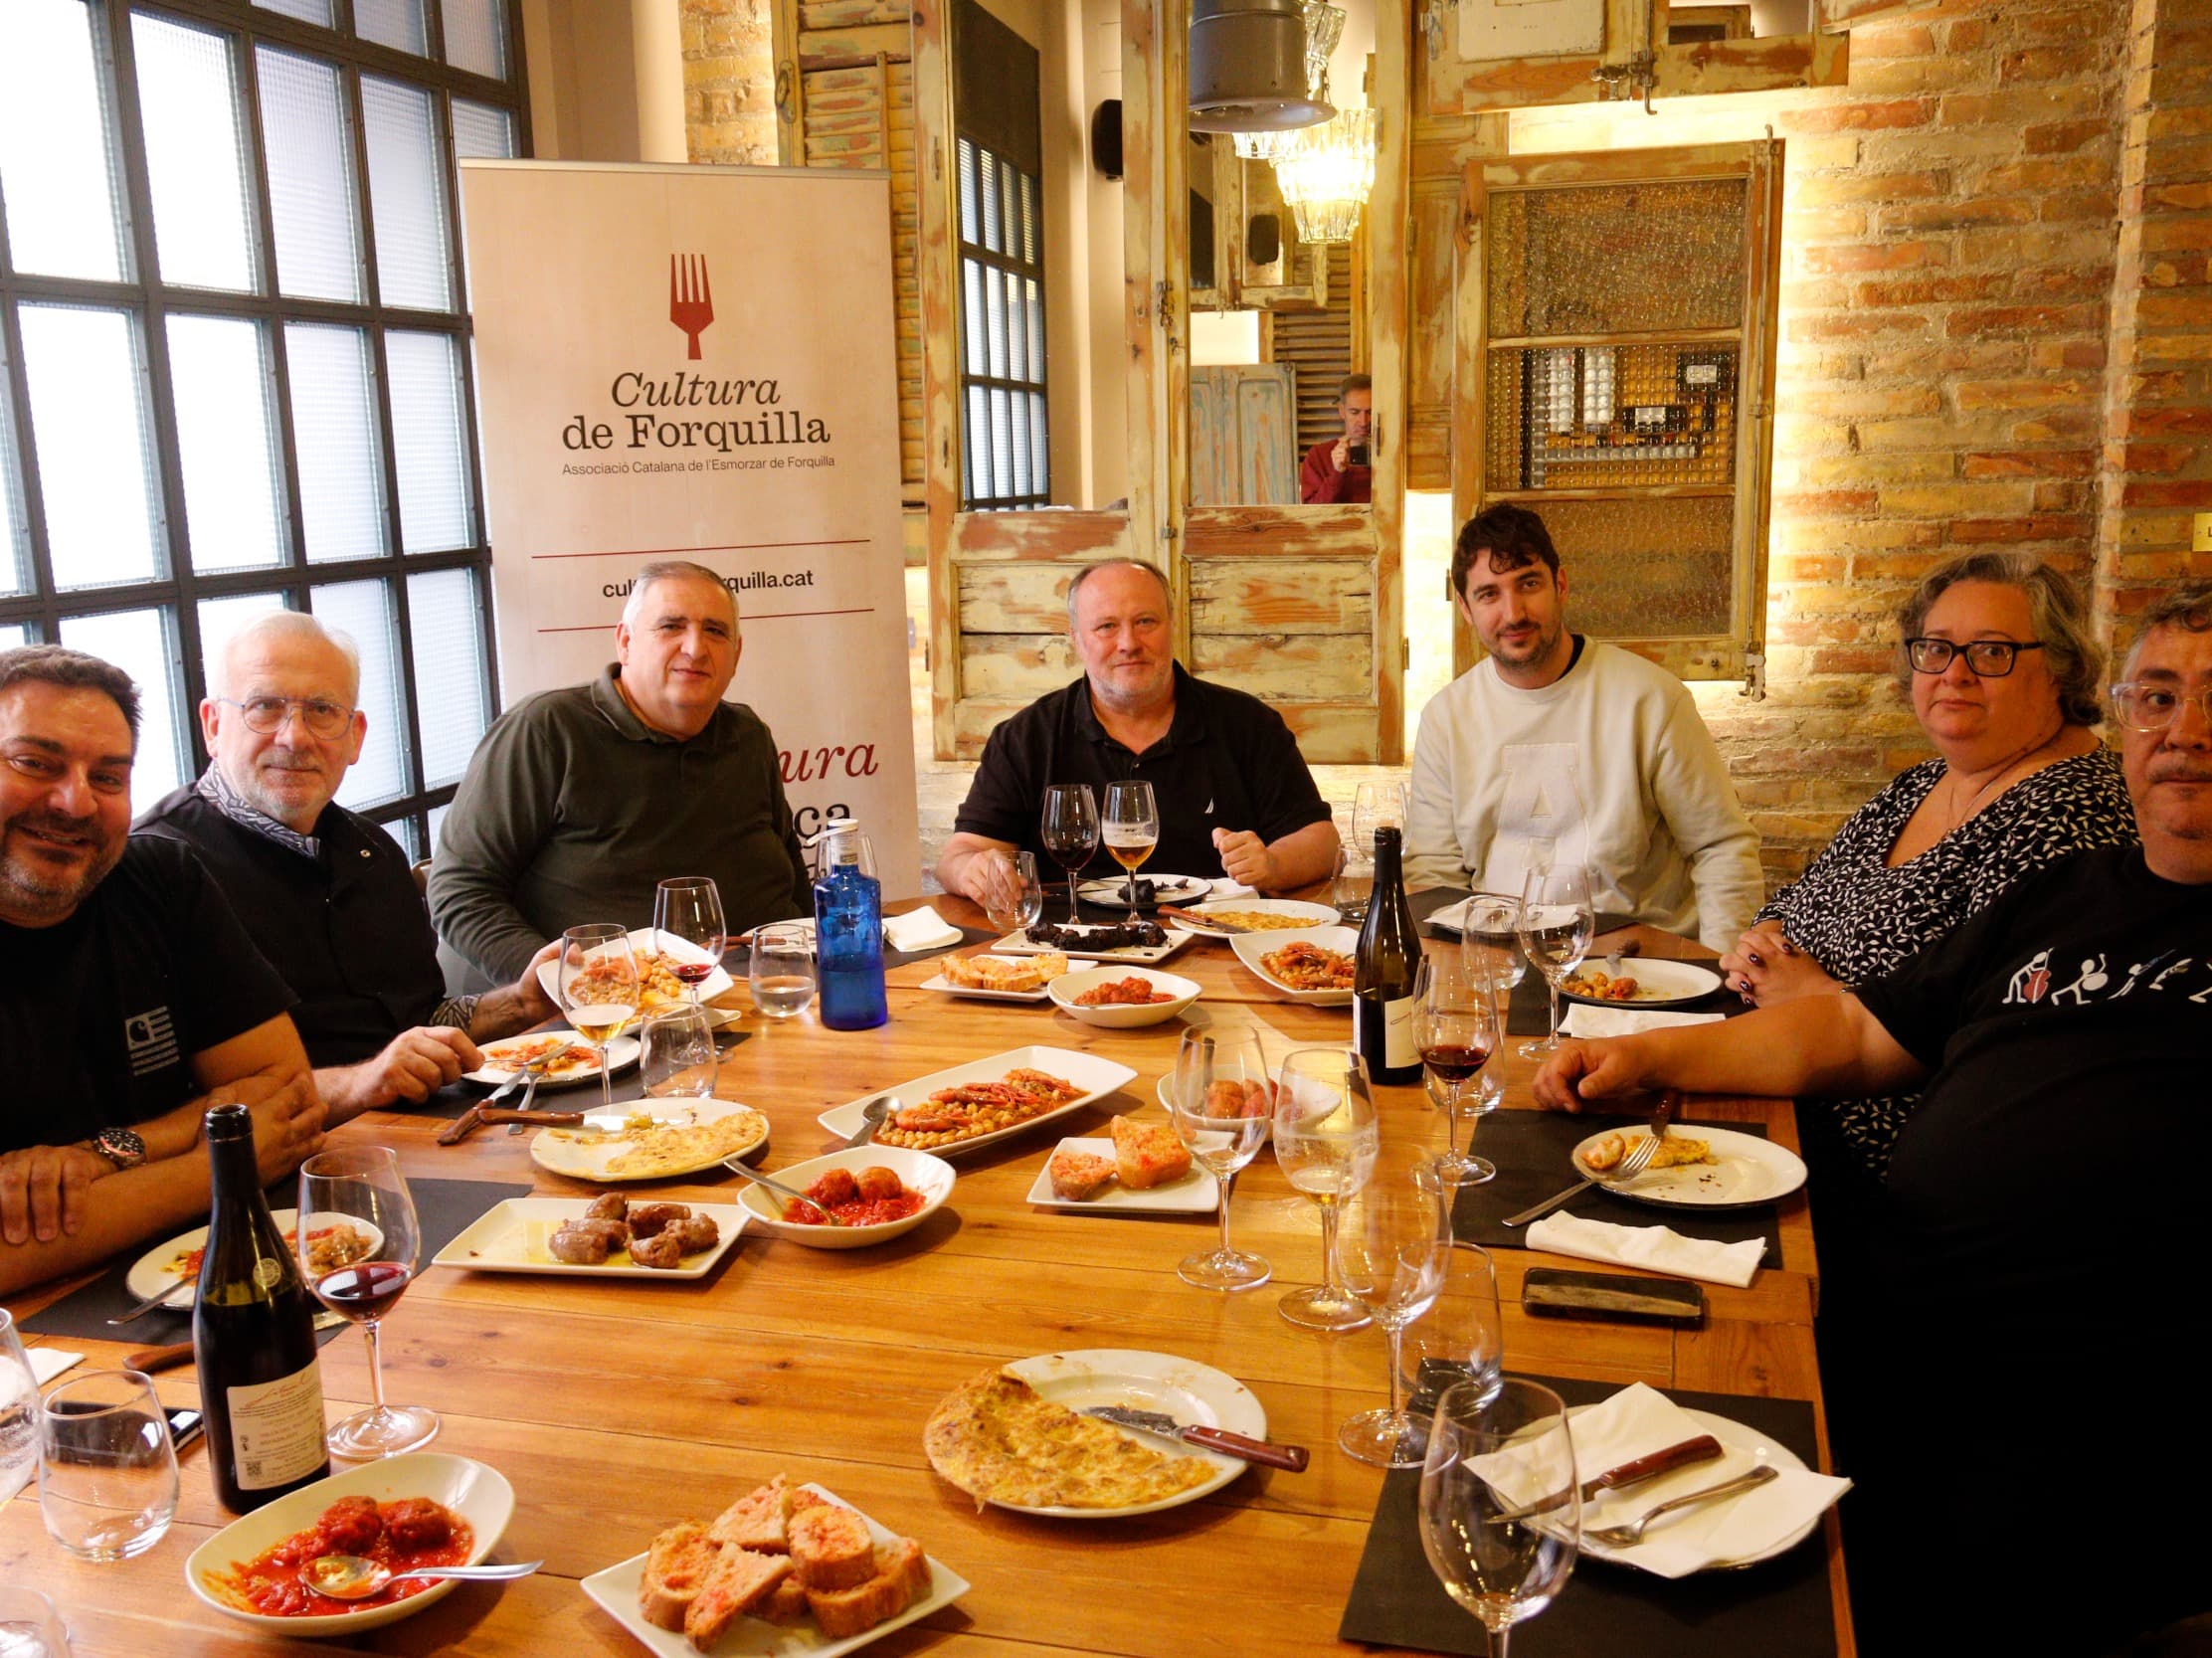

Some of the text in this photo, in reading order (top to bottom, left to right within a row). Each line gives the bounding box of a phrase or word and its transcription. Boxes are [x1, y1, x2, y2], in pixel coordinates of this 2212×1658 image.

[611, 371, 781, 407] Cultura
[562, 411, 830, 453] de Forquilla
[562, 457, 835, 475] Associació Catalana de l'Esmorzar de Forquilla
[779, 744, 879, 783] ura
